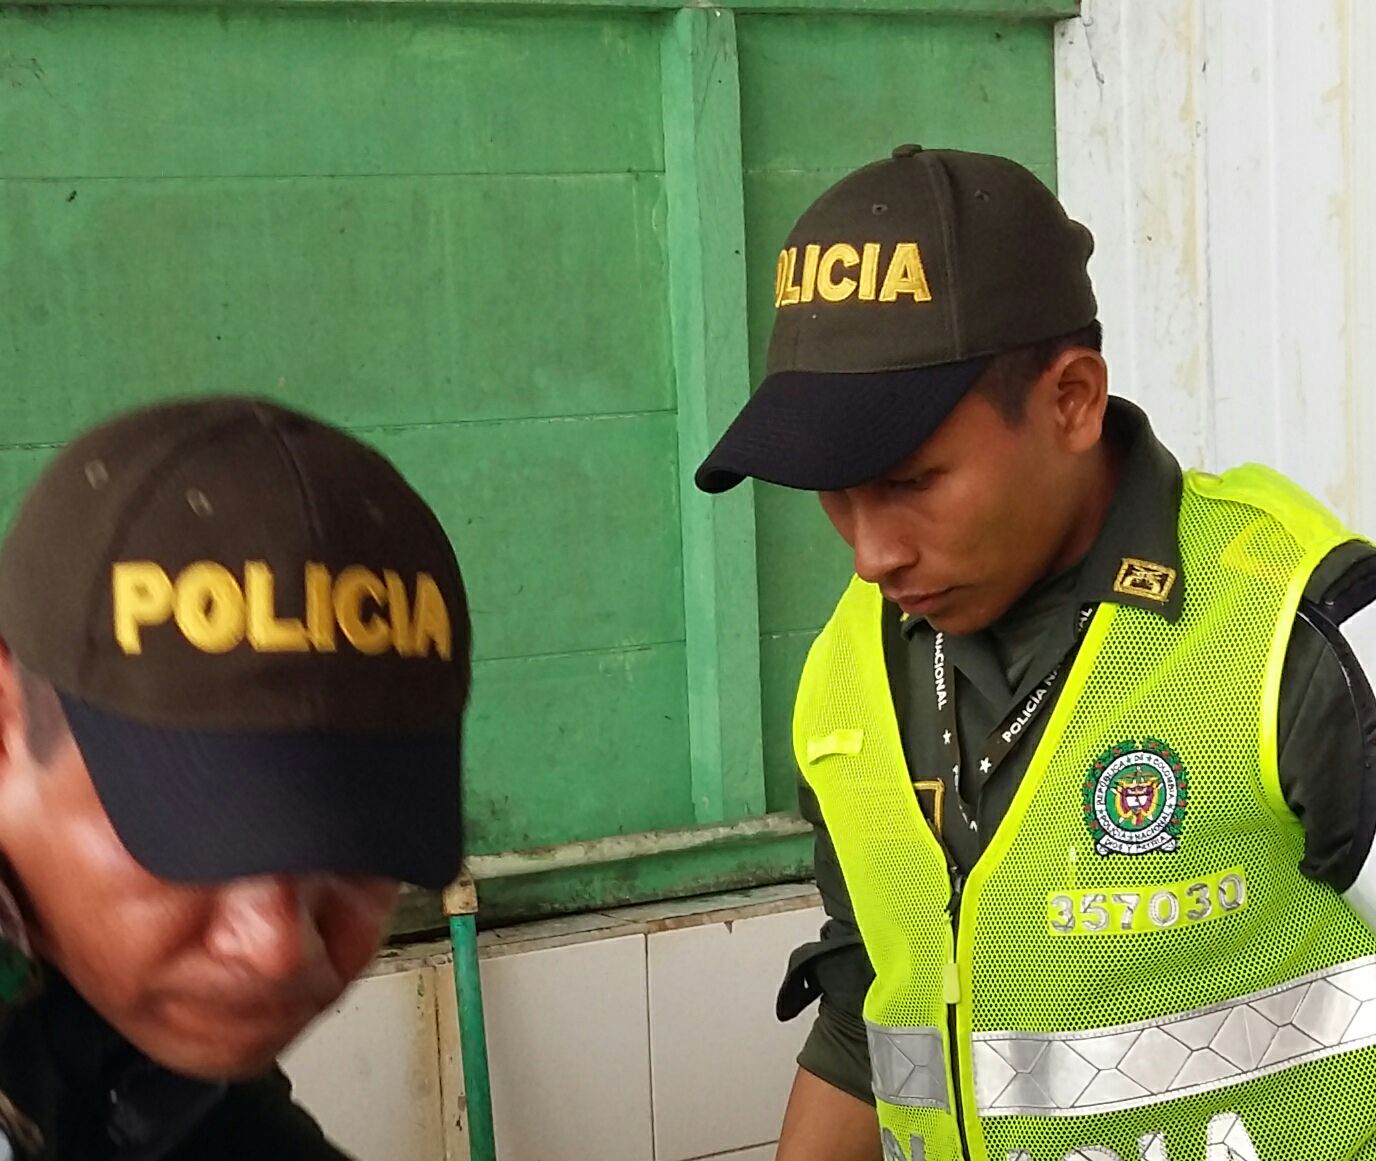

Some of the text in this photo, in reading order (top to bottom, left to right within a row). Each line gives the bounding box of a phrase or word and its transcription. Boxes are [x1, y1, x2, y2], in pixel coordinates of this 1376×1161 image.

[775, 243, 932, 308] OLICIA
[112, 560, 453, 661] POLICIA
[1050, 873, 1245, 932] 357030
